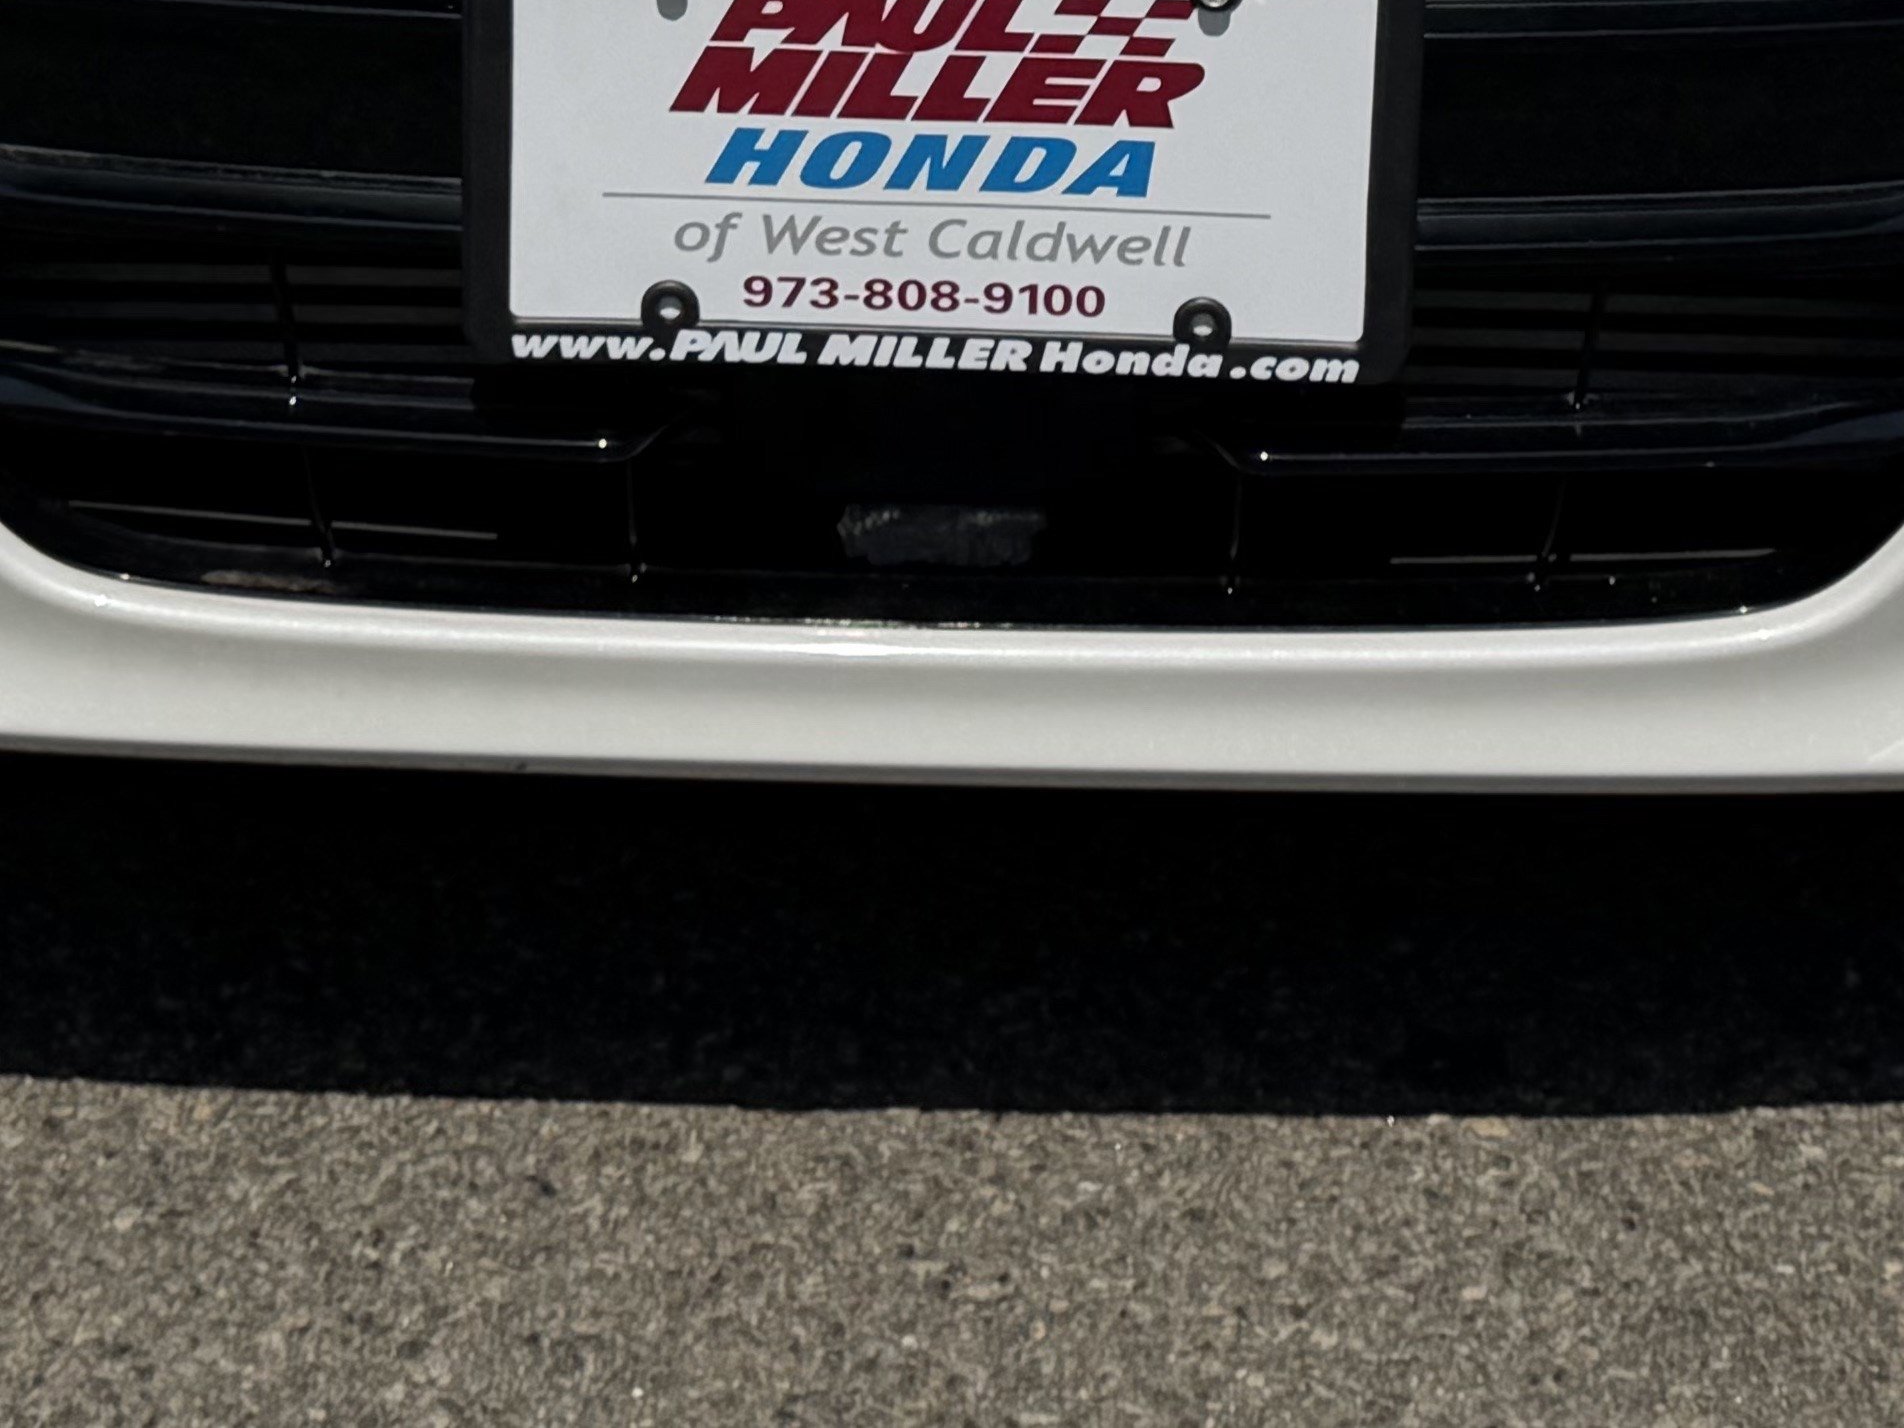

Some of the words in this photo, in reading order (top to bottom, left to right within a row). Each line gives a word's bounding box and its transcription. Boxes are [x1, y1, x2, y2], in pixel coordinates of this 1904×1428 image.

[669, 45, 1206, 129] MILLER
[704, 126, 1157, 200] HONDA
[674, 211, 743, 263] of
[762, 213, 910, 258] West
[928, 218, 1192, 268] Caldwell
[743, 275, 1107, 318] 973-808-9100
